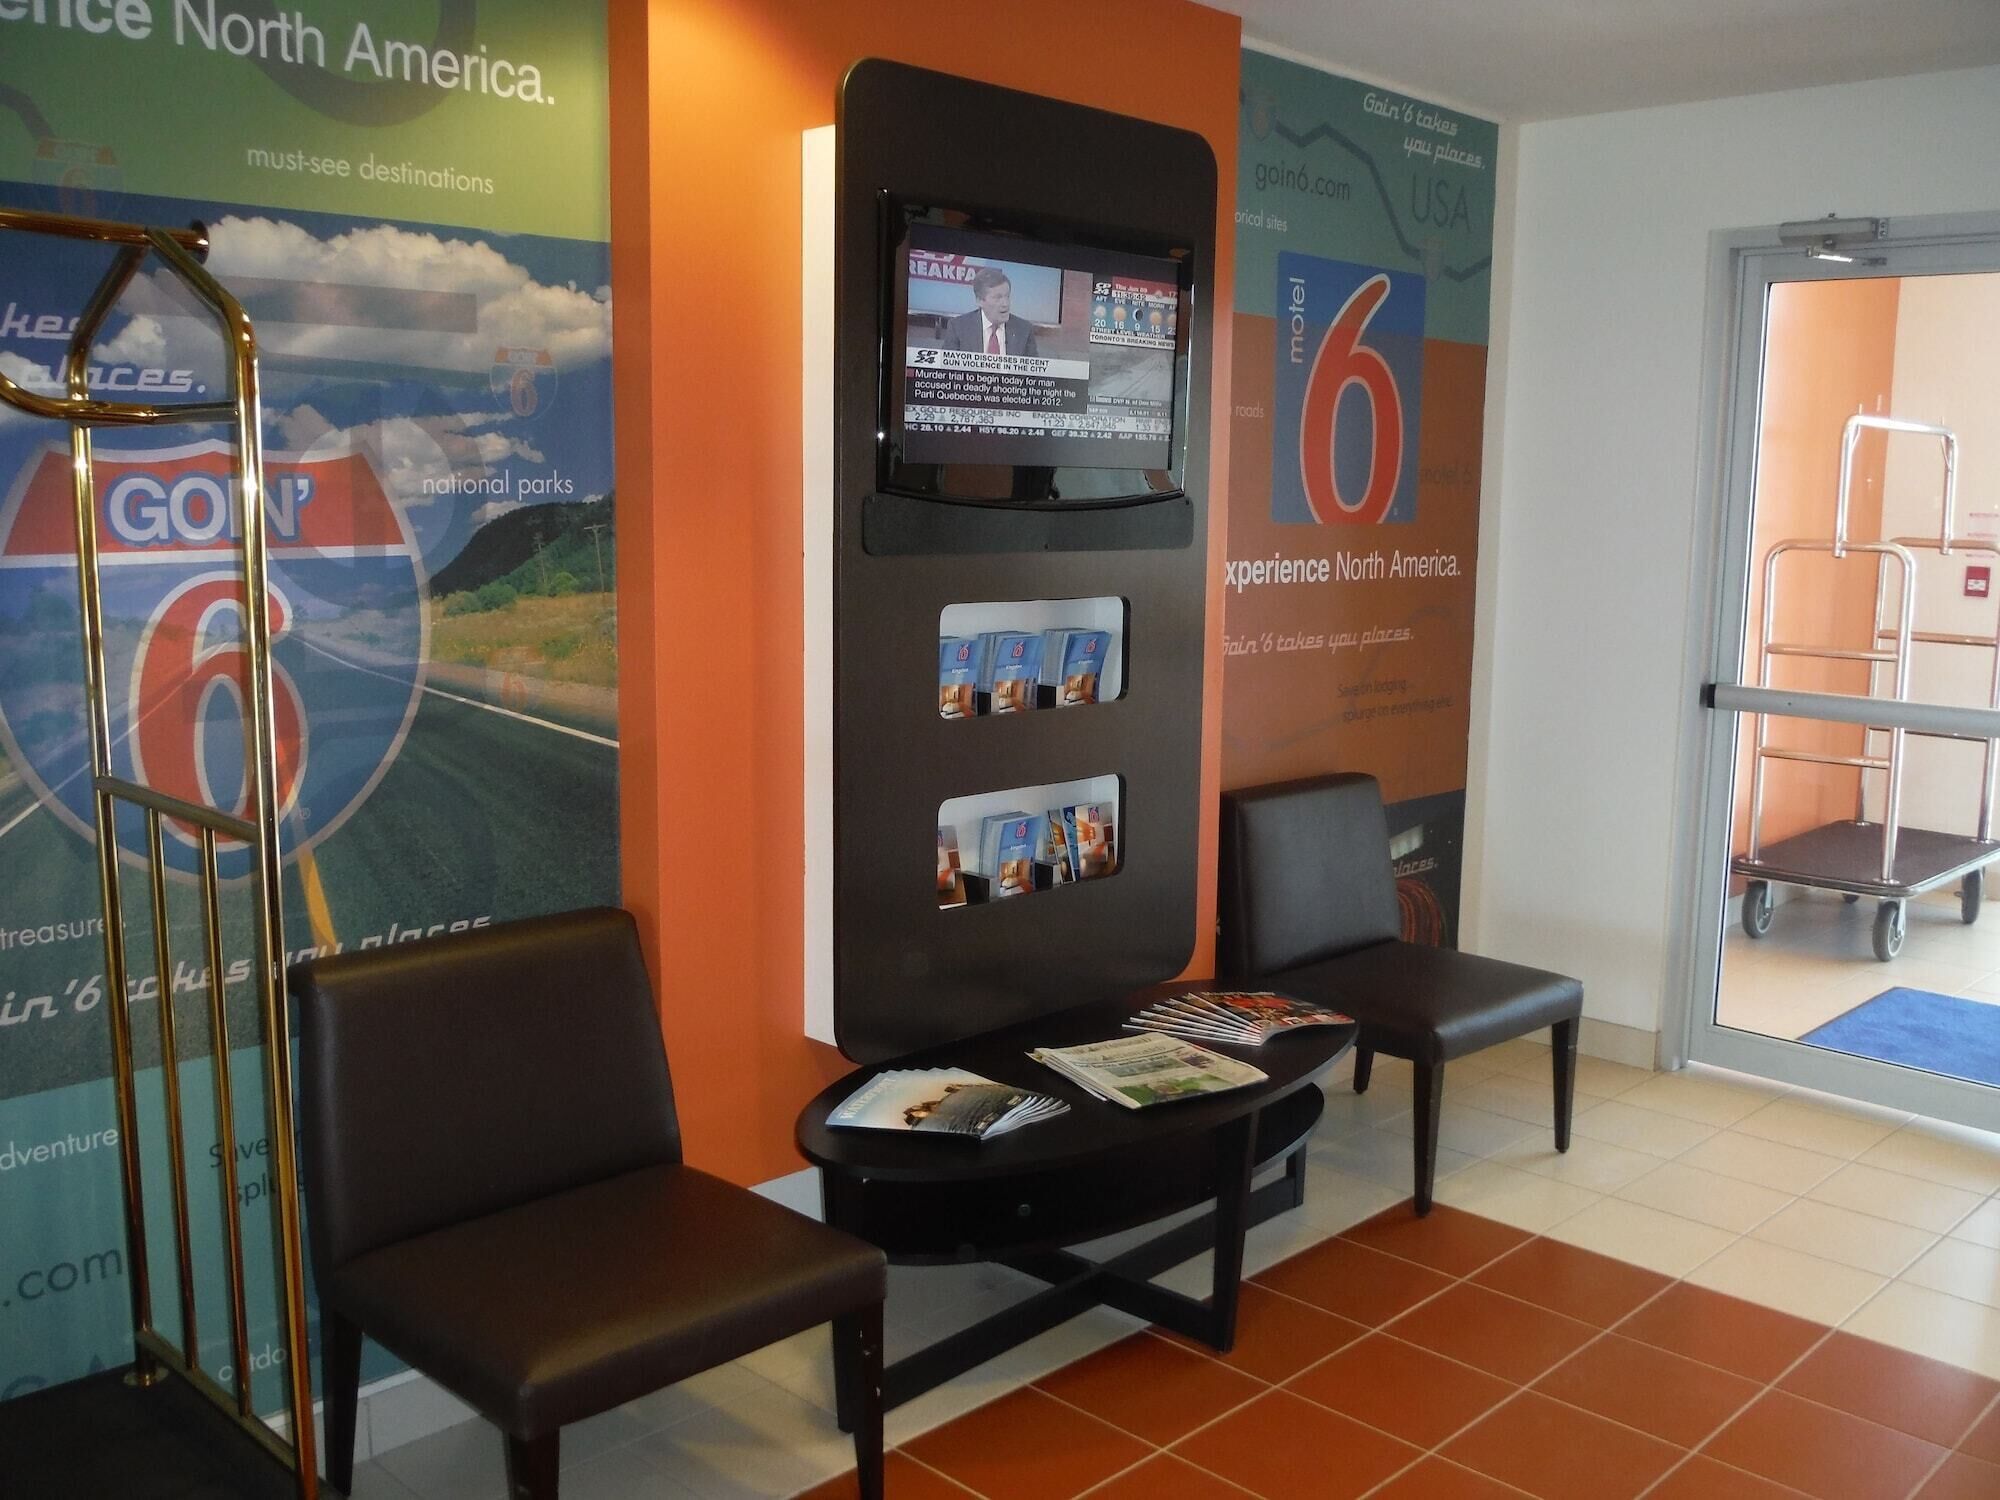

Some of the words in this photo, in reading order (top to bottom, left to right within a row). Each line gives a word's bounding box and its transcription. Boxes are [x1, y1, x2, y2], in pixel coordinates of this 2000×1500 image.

[173, 0, 326, 67] North
[344, 22, 556, 105] America.
[1416, 108, 1458, 136] takes
[1403, 135, 1432, 158] you
[1433, 144, 1486, 169] places.
[247, 147, 351, 178] must-see
[359, 153, 494, 194] destinations
[1255, 161, 1350, 200] goin6.com
[1411, 172, 1472, 233] USA
[1266, 213, 1288, 232] sites
[1094, 319, 1106, 328] 20
[1115, 321, 1125, 330] 16
[1135, 323, 1141, 331] 9
[1151, 325, 1161, 334] 15
[1289, 277, 1305, 363] motel
[943, 351, 972, 360] MAYOR
[974, 354, 1018, 364] DISCUSSES
[1020, 357, 1050, 366] RECENT
[943, 359, 961, 367] GUN
[963, 361, 1001, 370] VIOLENCE
[1030, 365, 1047, 373] CITY
[914, 380, 951, 390] accused
[953, 381, 961, 390] in
[963, 382, 991, 394] deadly
[992, 384, 1027, 396] shooting
[1028, 386, 1042, 395] the
[1043, 387, 1062, 398] night
[1063, 389, 1076, 398] the
[915, 369, 946, 379] Murder
[948, 371, 964, 380] trial
[966, 372, 975, 382] to
[976, 372, 1000, 385] begin
[1001, 375, 1024, 387] today
[1025, 377, 1036, 386] for
[1038, 379, 1056, 387] man
[914, 390, 934, 399] Parti
[936, 390, 982, 402] Quebecois
[1002, 395, 1030, 405] elected
[1032, 396, 1040, 405] in
[1041, 397, 1063, 406] 2012.
[920, 406, 946, 414] GOLD
[949, 407, 1004, 417] RESOURCES
[1006, 410, 1020, 418] INC
[1235, 400, 1264, 418] roads
[1300, 273, 1403, 524] 6
[422, 471, 511, 496] national
[518, 472, 574, 503] parks
[1336, 551, 1384, 581] North
[1389, 549, 1461, 579] America.
[1277, 631, 1324, 652] takes
[1328, 632, 1358, 655] you
[1360, 625, 1414, 652] places.
[0, 916, 126, 951] treasure
[209, 1137, 271, 1169] Sve
